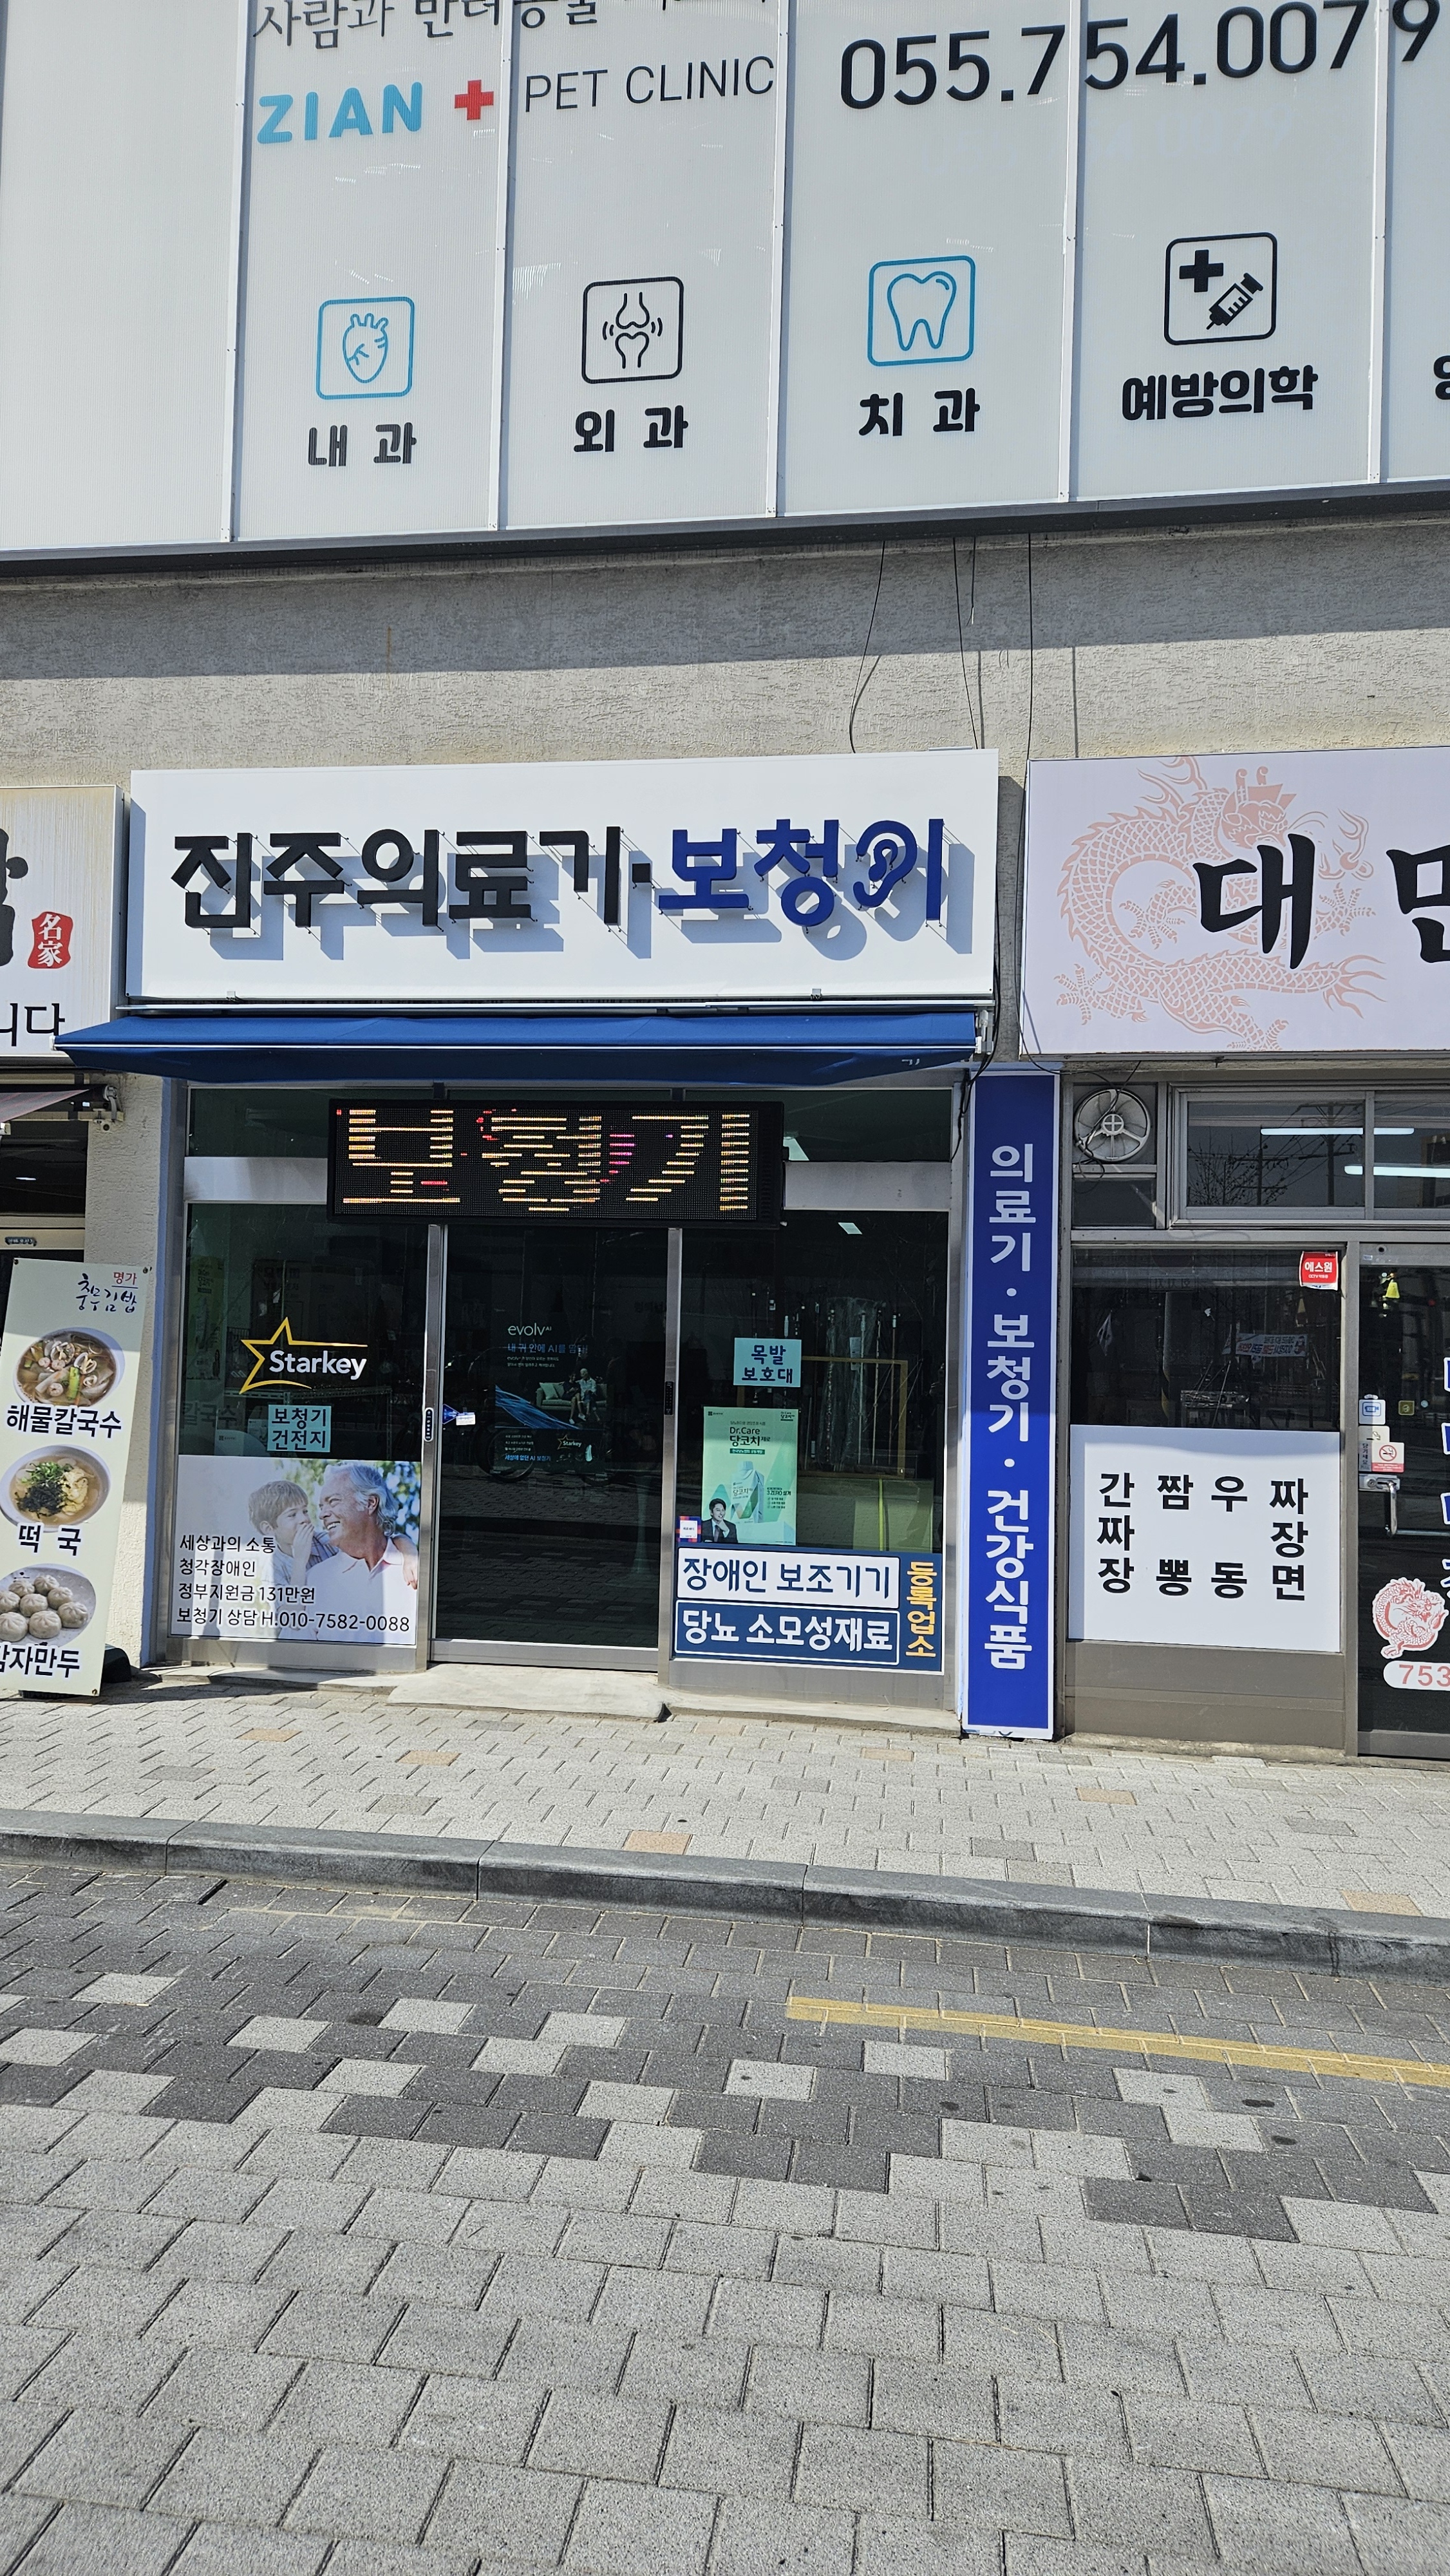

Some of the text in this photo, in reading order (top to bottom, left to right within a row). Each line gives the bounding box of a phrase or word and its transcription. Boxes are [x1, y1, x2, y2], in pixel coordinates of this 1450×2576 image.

[257, 55, 774, 145] ZIAN PET CLINIC
[1121, 364, 1319, 421] 예방의학
[37, 913, 63, 967] 名家
[113, 1272, 137, 1285] 명가
[1304, 1262, 1333, 1273] 에스원
[269, 1349, 368, 1379] Starkey
[751, 1344, 787, 1366] 목발
[741, 1366, 794, 1385] 보호대
[984, 1142, 1036, 1670] 의료기 보청기 건강식품
[6, 1405, 122, 1438] 해물칼국수
[271, 1407, 326, 1430] 보청기
[272, 1430, 326, 1450] 건전지
[730, 1426, 760, 1435] Dr.Care
[730, 1435, 760, 1447] 당코치
[180, 1535, 276, 1553] 세상과의 소통
[179, 1558, 256, 1577] 청각장애인
[682, 1557, 890, 1600] 장애인 보조기기
[178, 1582, 315, 1604] 정부지원금 131만원
[176, 1607, 223, 1625] 보청기
[227, 1609, 258, 1626] 상담
[905, 1561, 937, 1659] 등록업소
[682, 1609, 893, 1653] 당뇨 소모성재료
